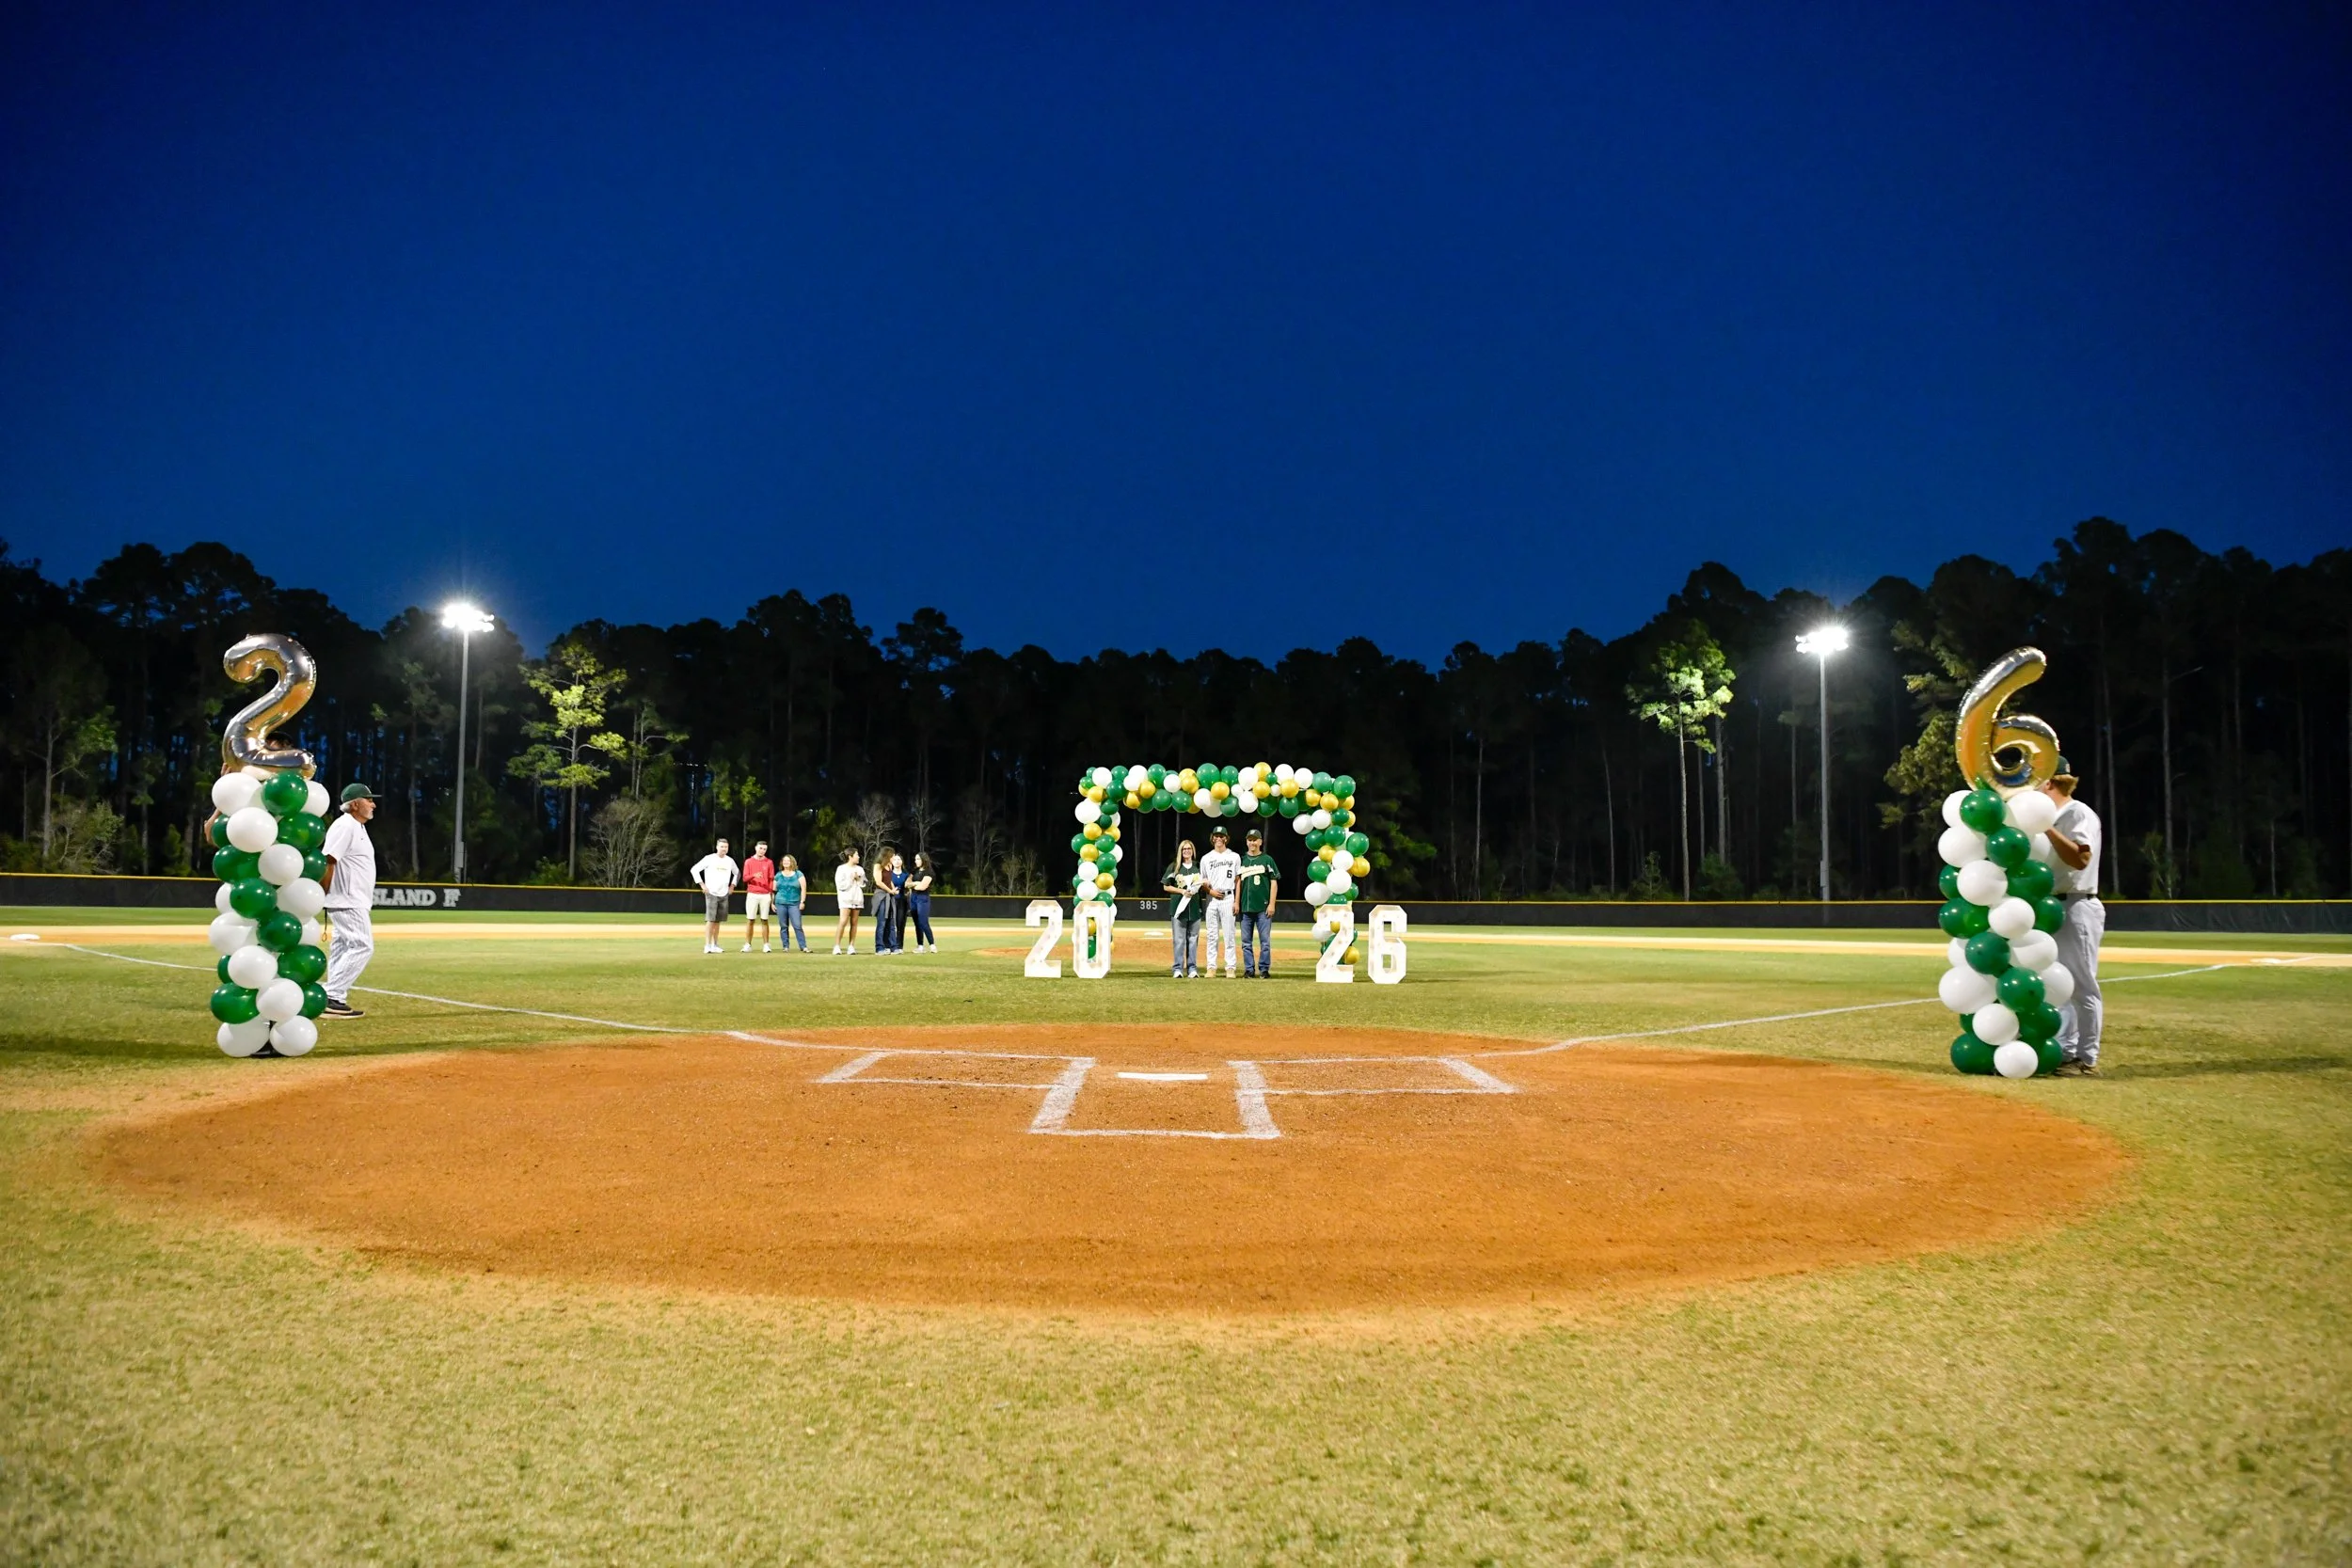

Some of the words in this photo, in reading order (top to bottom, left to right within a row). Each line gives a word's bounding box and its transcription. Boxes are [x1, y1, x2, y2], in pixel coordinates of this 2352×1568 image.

[223, 633, 317, 780] 2
[1956, 645, 2060, 798] 6
[1139, 900, 1158, 911] 385
[1226, 869, 1232, 879] 6
[1024, 899, 1111, 978] 20
[1315, 904, 1407, 985] 26
